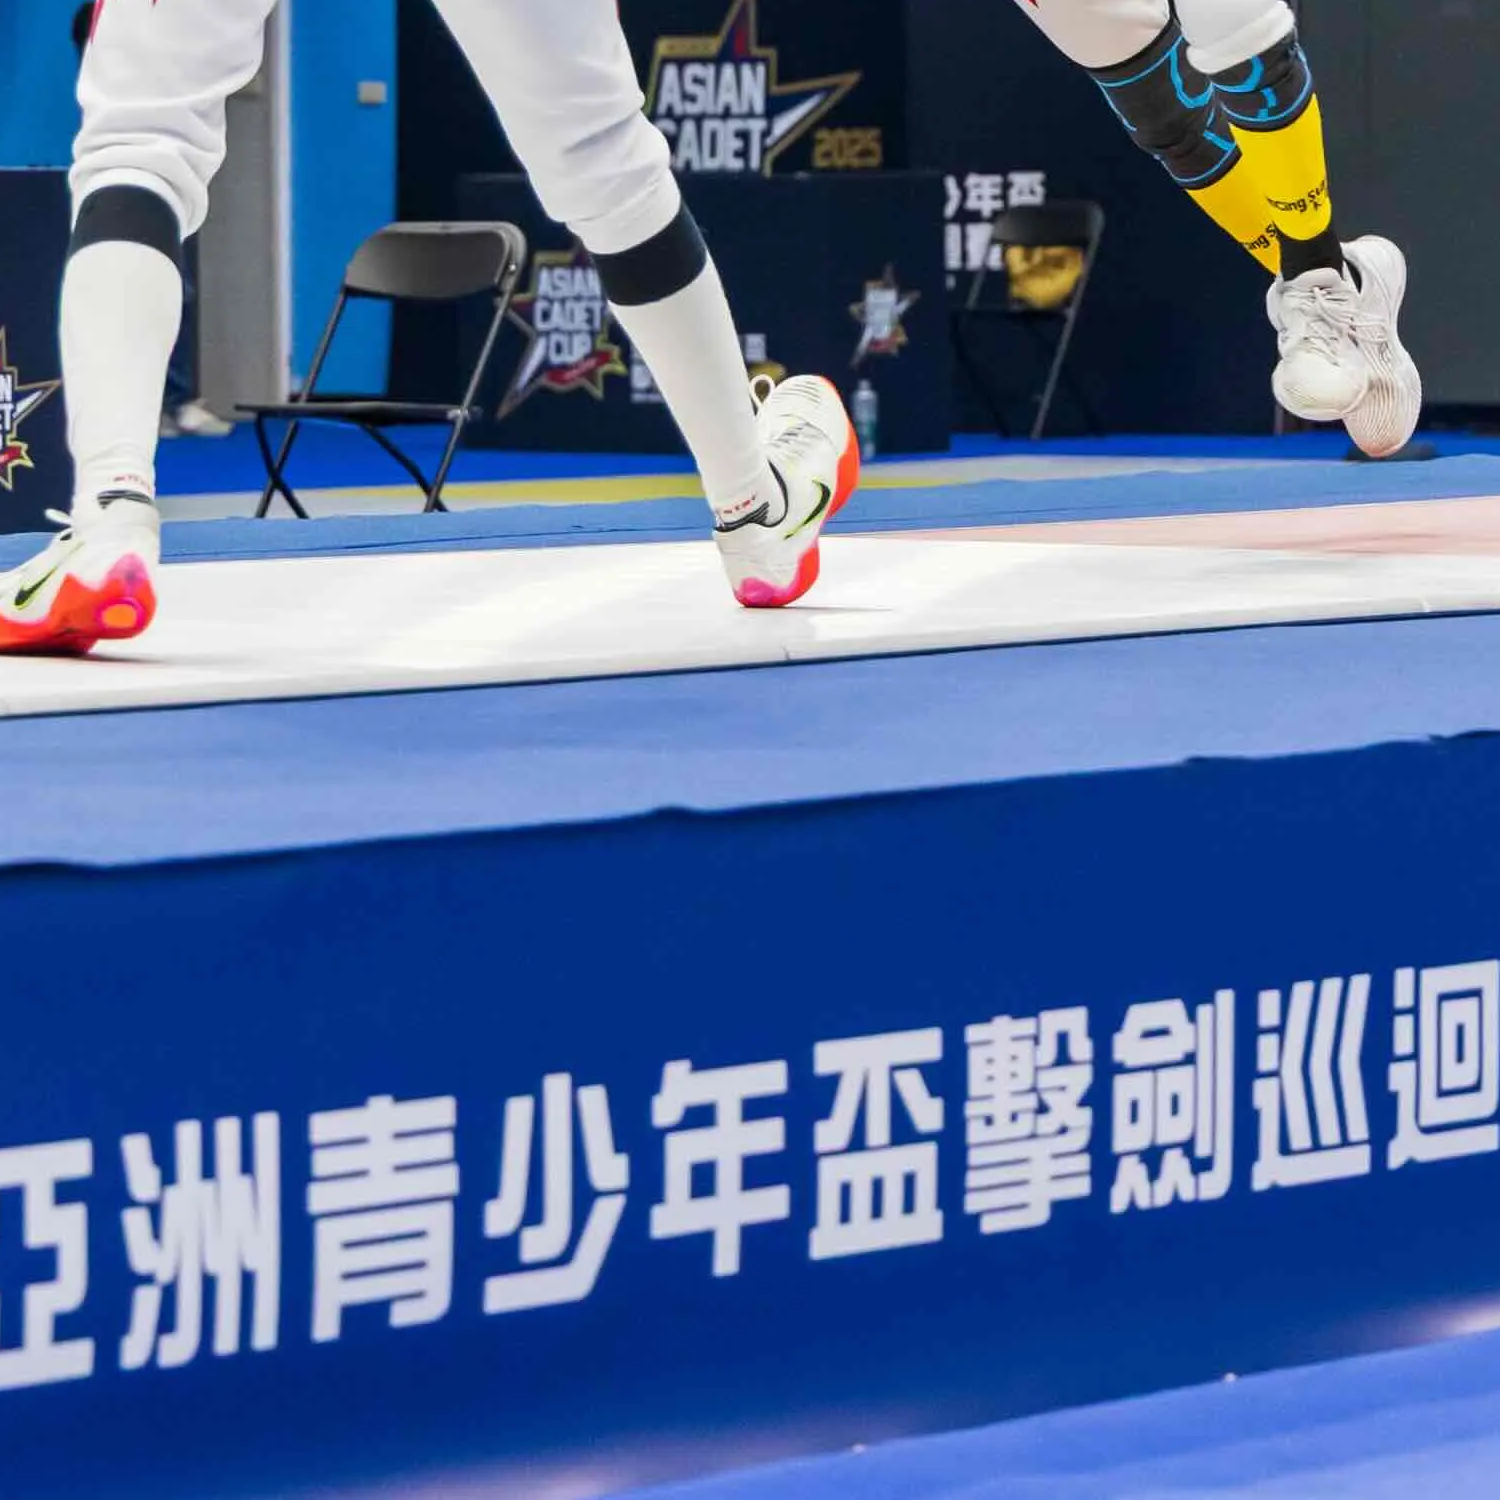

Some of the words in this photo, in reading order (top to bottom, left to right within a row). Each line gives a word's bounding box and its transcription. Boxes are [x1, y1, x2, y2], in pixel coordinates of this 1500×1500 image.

[656, 62, 767, 117] ASIAN
[811, 127, 884, 169] 2025
[536, 266, 602, 300] ASIAN
[532, 300, 605, 333] CADET
[547, 334, 594, 367] CUP
